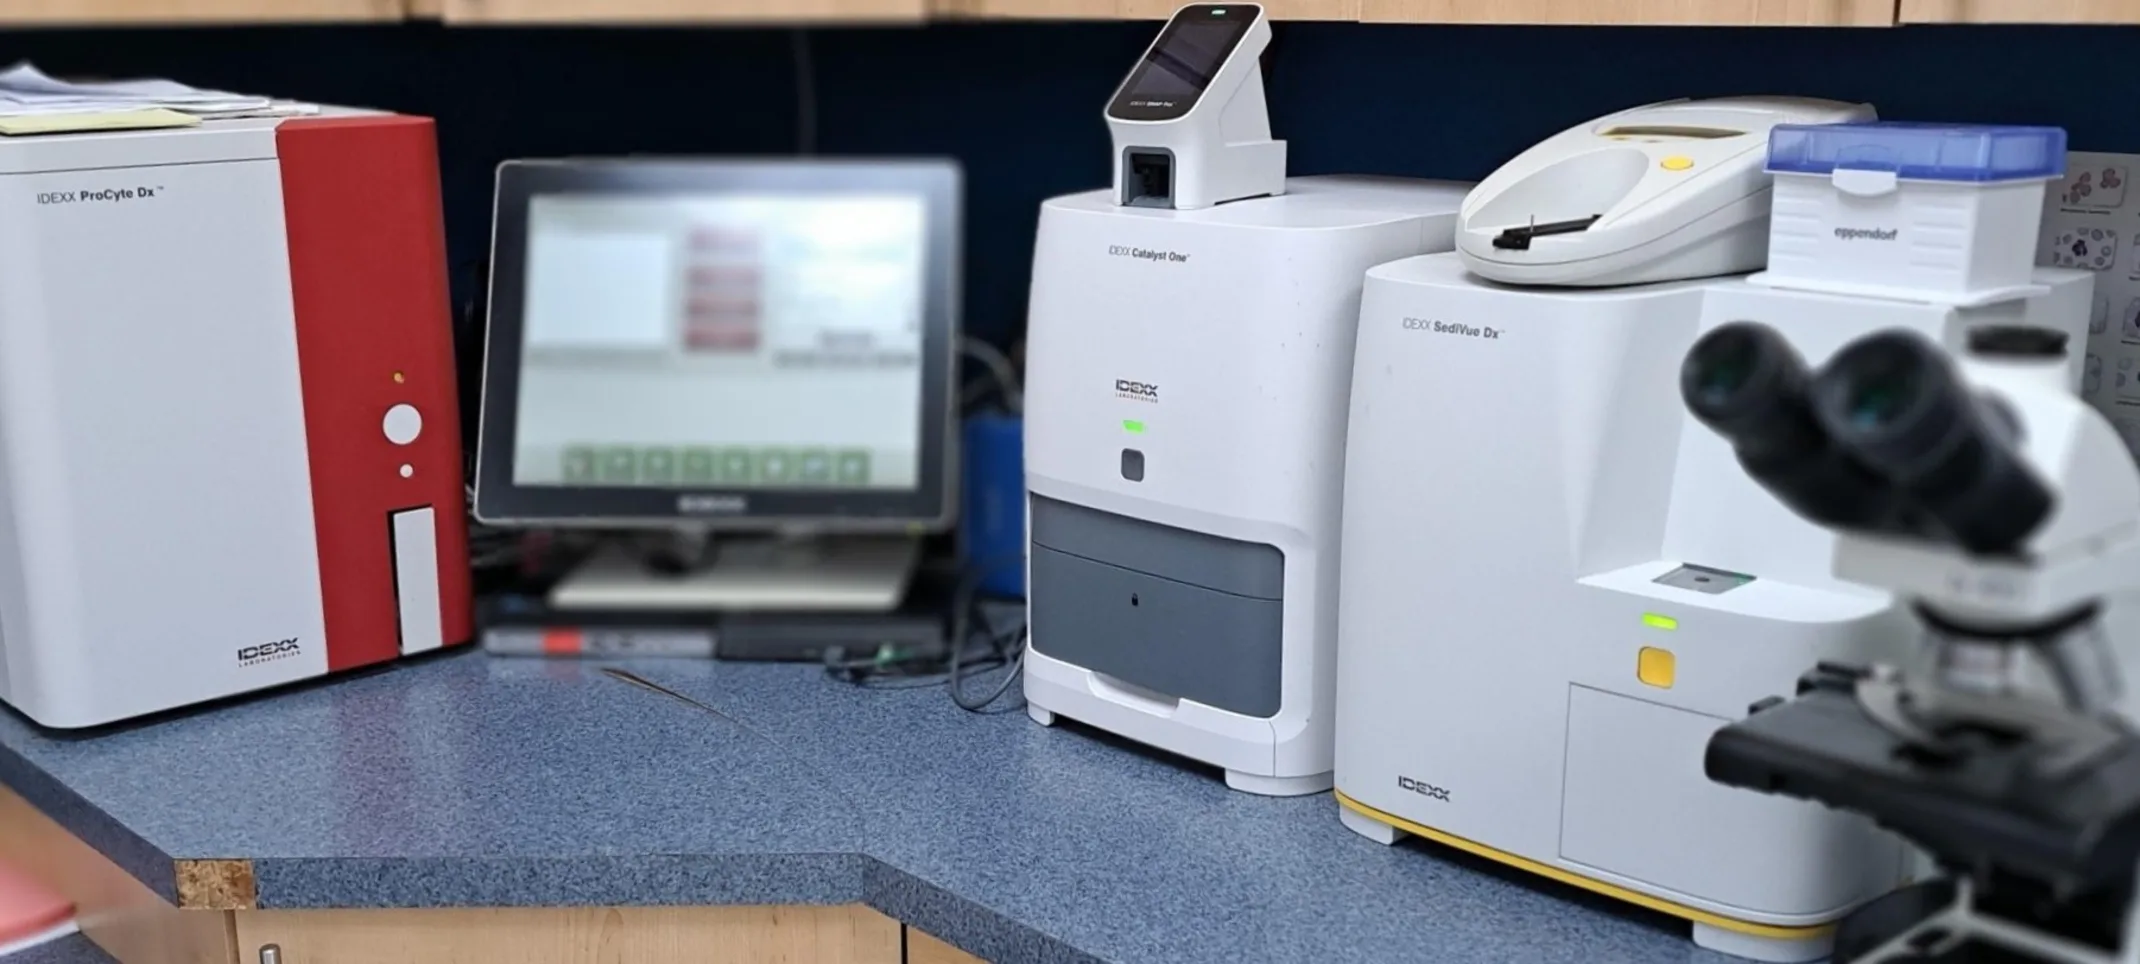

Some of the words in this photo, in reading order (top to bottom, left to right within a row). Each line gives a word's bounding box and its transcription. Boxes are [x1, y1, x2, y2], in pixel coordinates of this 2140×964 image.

[37, 191, 76, 204] IDEXX
[80, 189, 133, 202] ProCyte
[1834, 226, 1898, 242] eppendorf
[1132, 247, 1167, 262] Catalyst
[1402, 317, 1431, 330] IDEXX
[1434, 320, 1480, 337] SediVue
[1115, 379, 1158, 397] IDEXX
[238, 637, 299, 660] IDEXX
[1398, 775, 1450, 803] IDEXX
